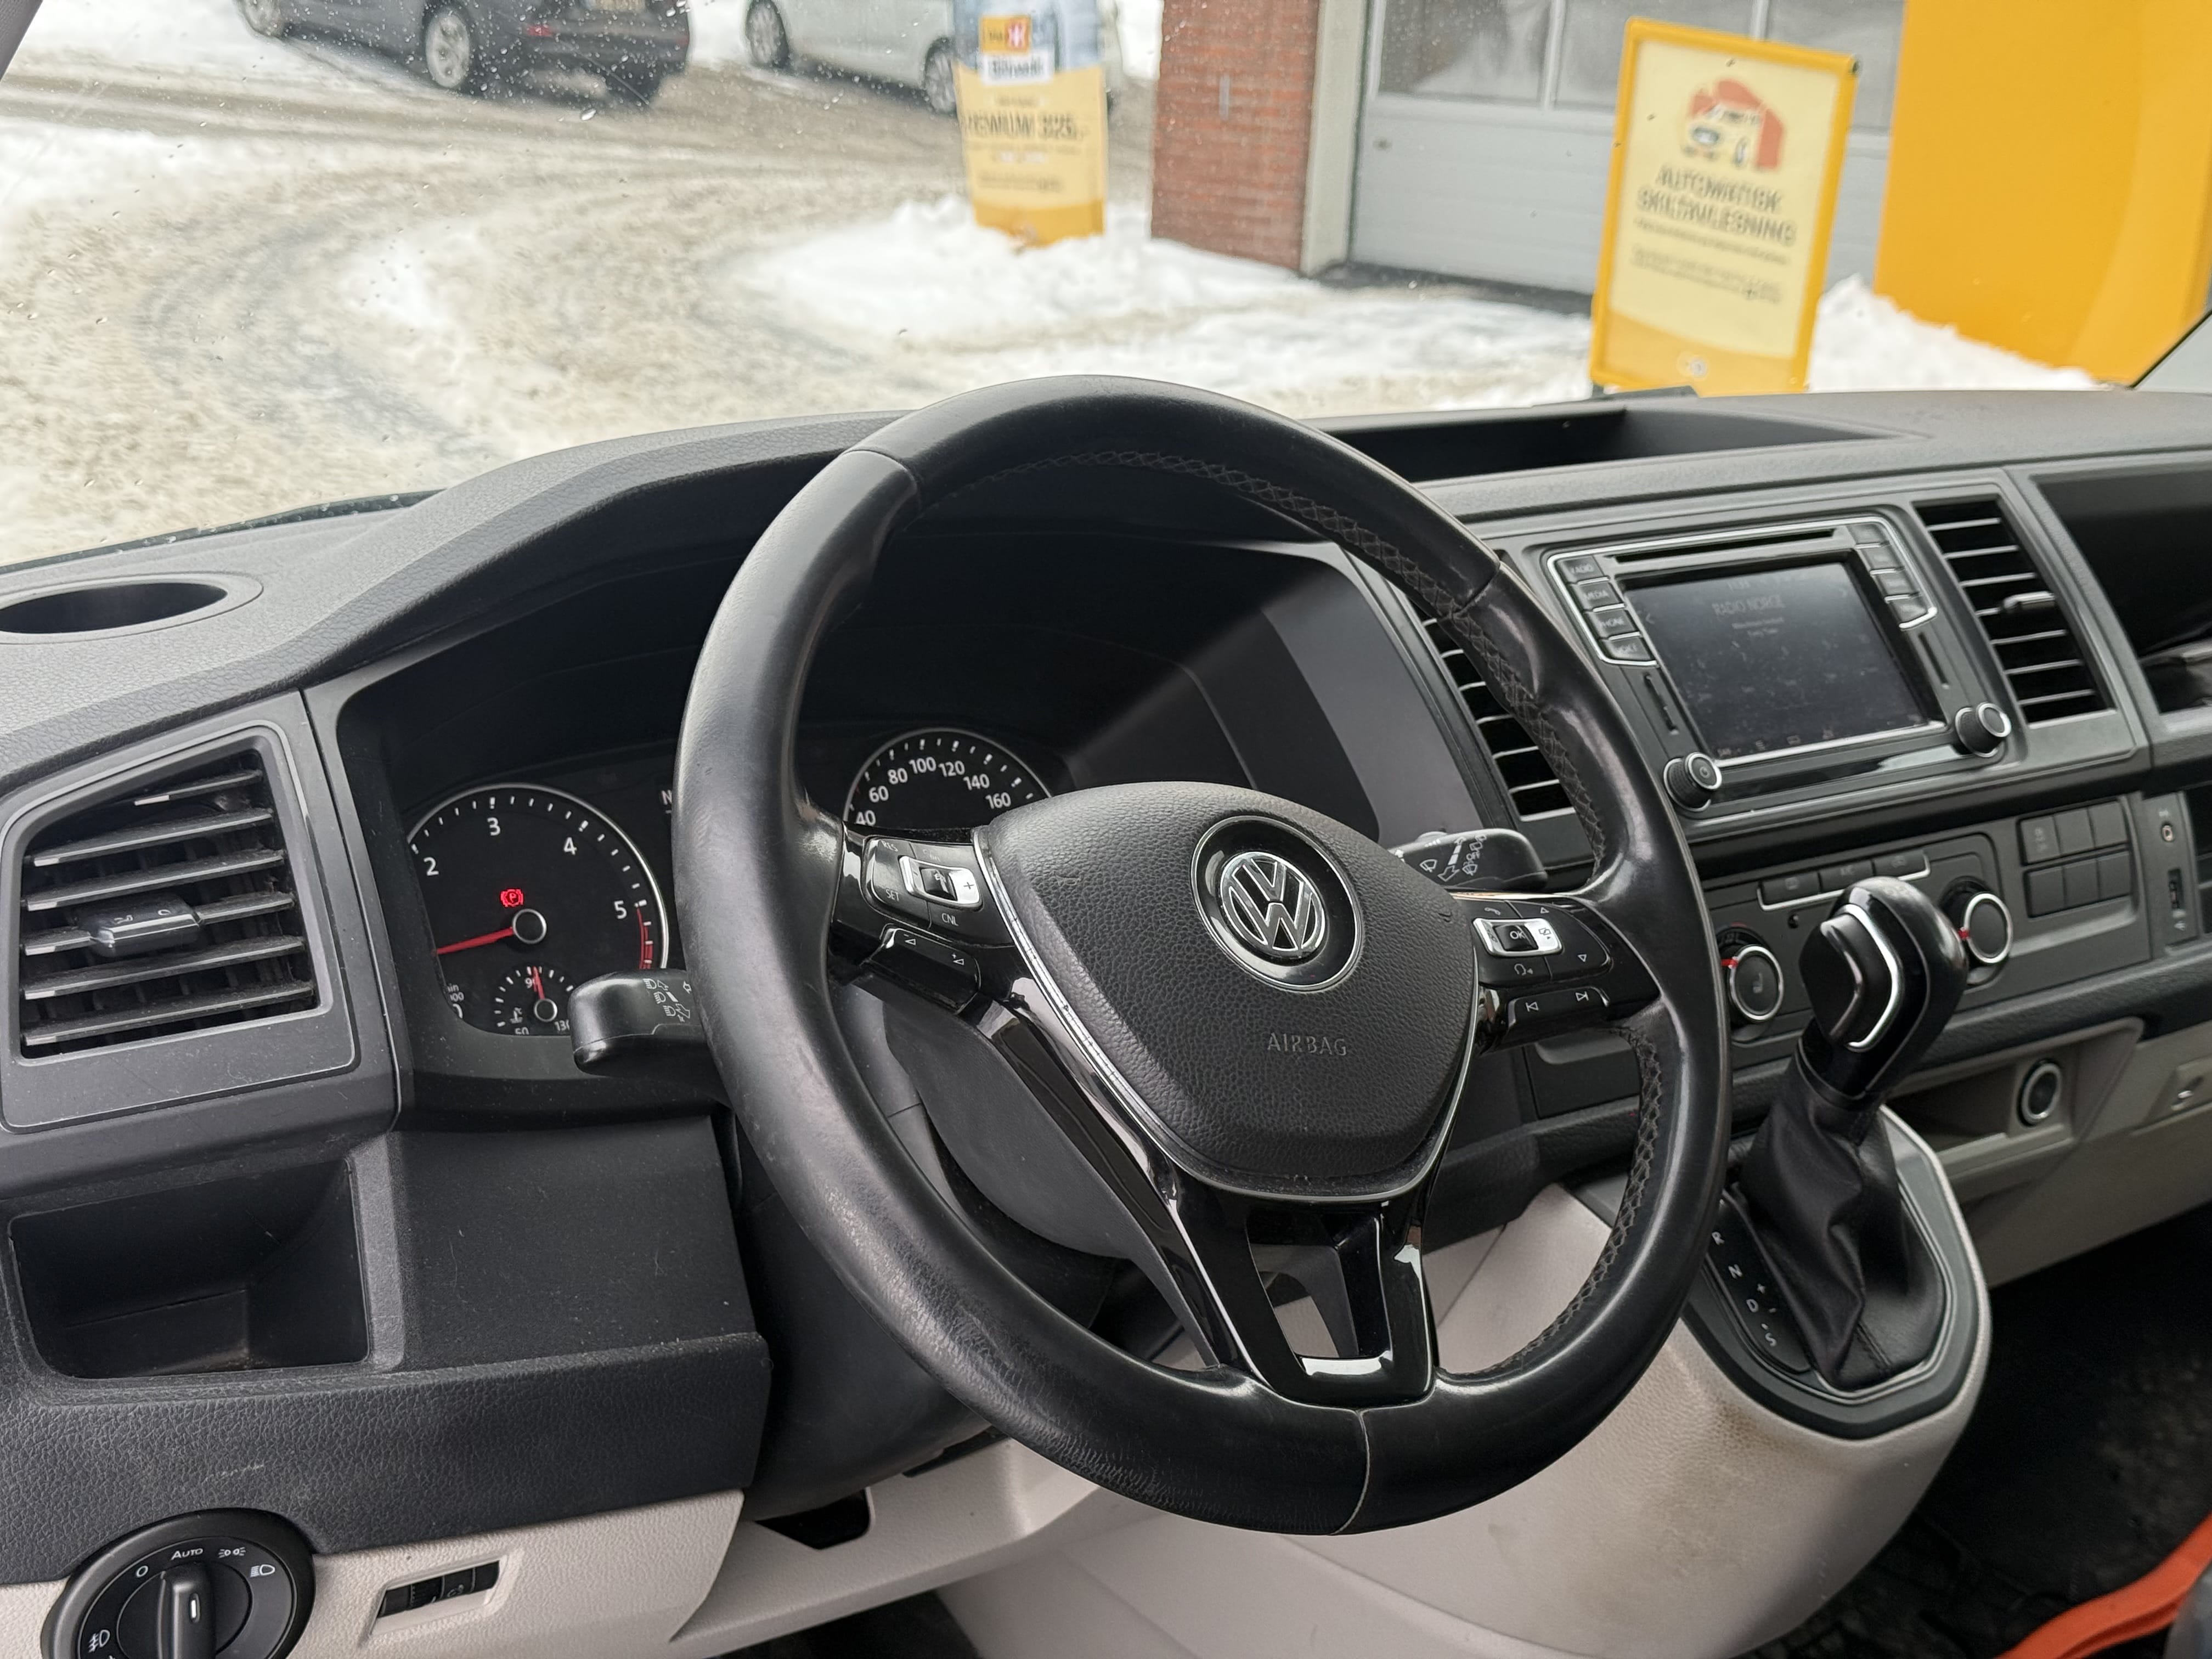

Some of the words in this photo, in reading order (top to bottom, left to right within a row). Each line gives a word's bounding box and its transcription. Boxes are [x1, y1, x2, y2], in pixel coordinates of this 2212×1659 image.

[909, 757, 936, 775] 100
[939, 760, 965, 777] 120
[888, 768, 908, 785] 80
[963, 774, 990, 791] 140
[868, 786, 889, 803] 60
[986, 792, 1012, 809] 160
[487, 817, 501, 836] 3
[855, 810, 876, 826] 40
[564, 837, 577, 855] 4
[424, 857, 439, 876] 2
[885, 889, 900, 901] SET
[614, 900, 627, 919] 5
[941, 913, 959, 927] CNL
[1510, 930, 1527, 940] OK
[1267, 1032, 1347, 1057] AIRBAG
[1711, 1231, 1725, 1245] R
[1728, 1263, 1743, 1279] N
[1746, 1299, 1759, 1313] D
[1764, 1332, 1778, 1347] S
